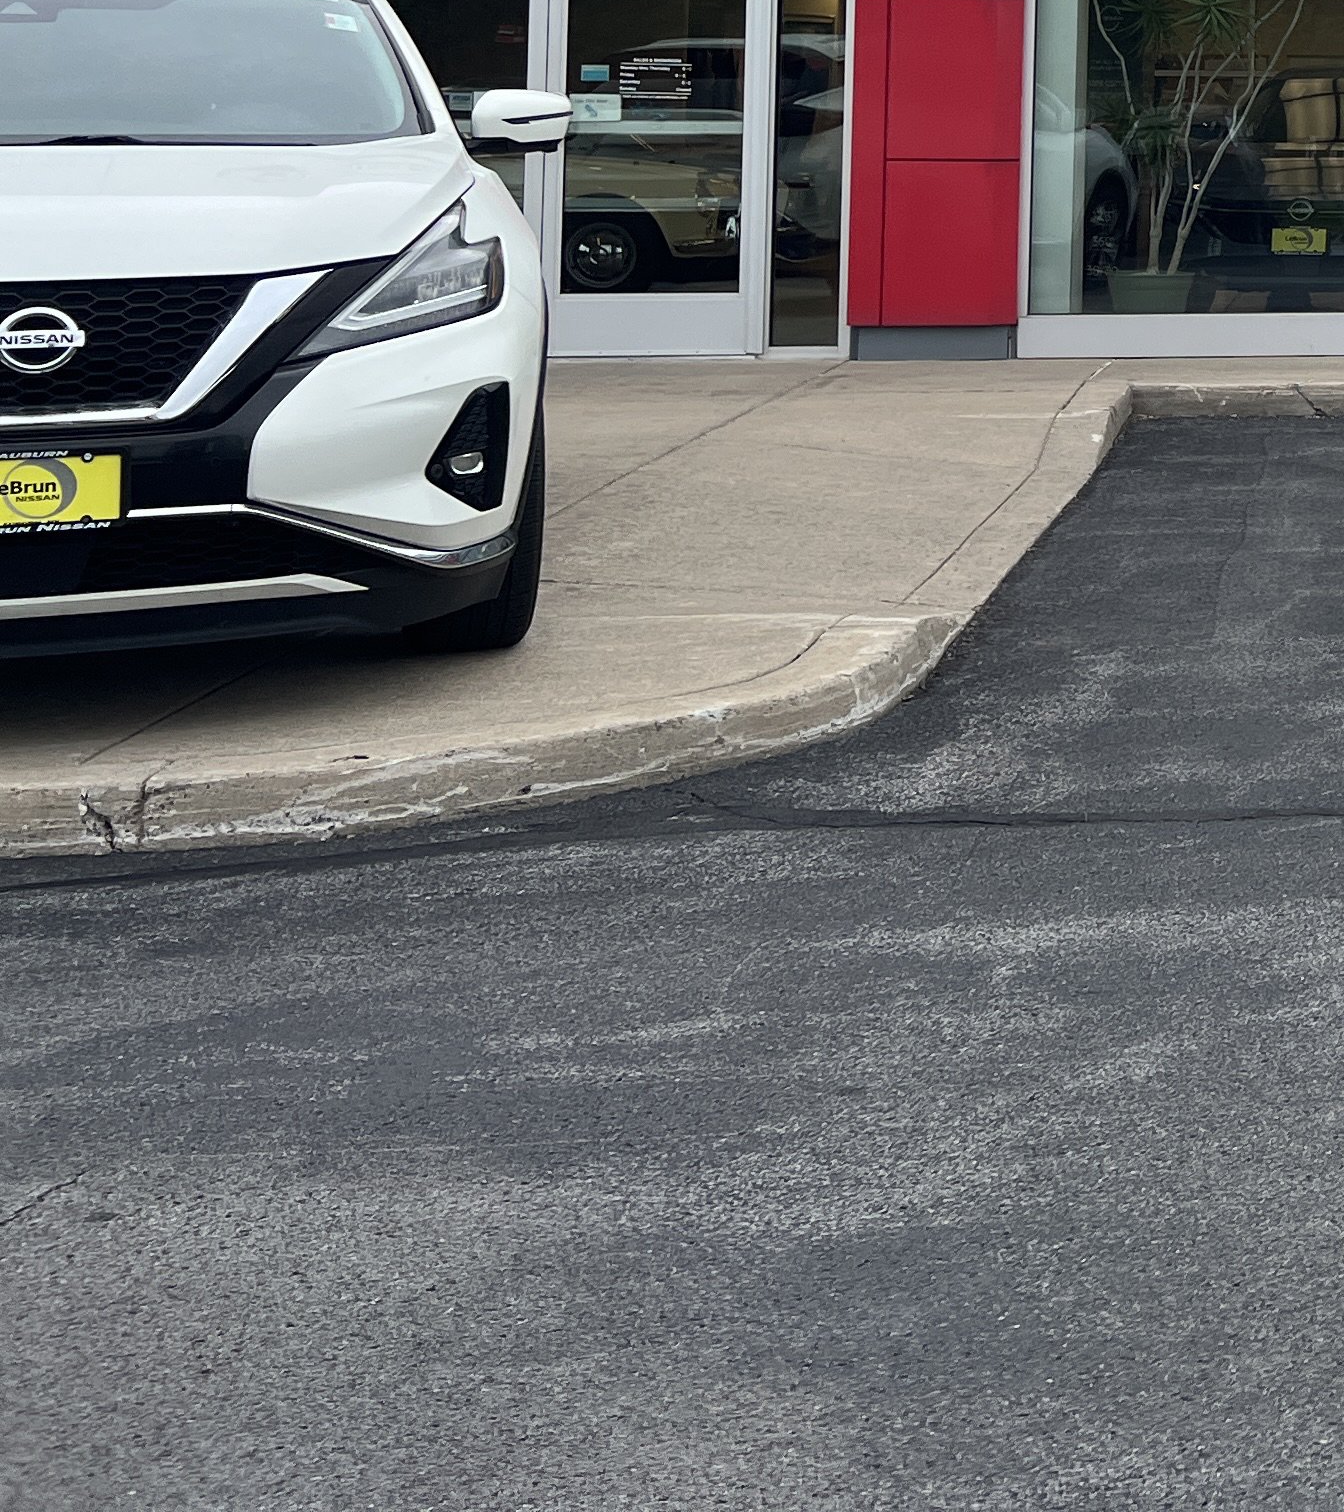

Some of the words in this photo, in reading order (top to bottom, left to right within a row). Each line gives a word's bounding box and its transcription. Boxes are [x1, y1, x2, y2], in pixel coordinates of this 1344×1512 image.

[0, 334, 74, 345] NISSAN
[0, 481, 57, 496] eBrun
[15, 494, 60, 502] NISSAN
[36, 521, 111, 532] NISSAN
